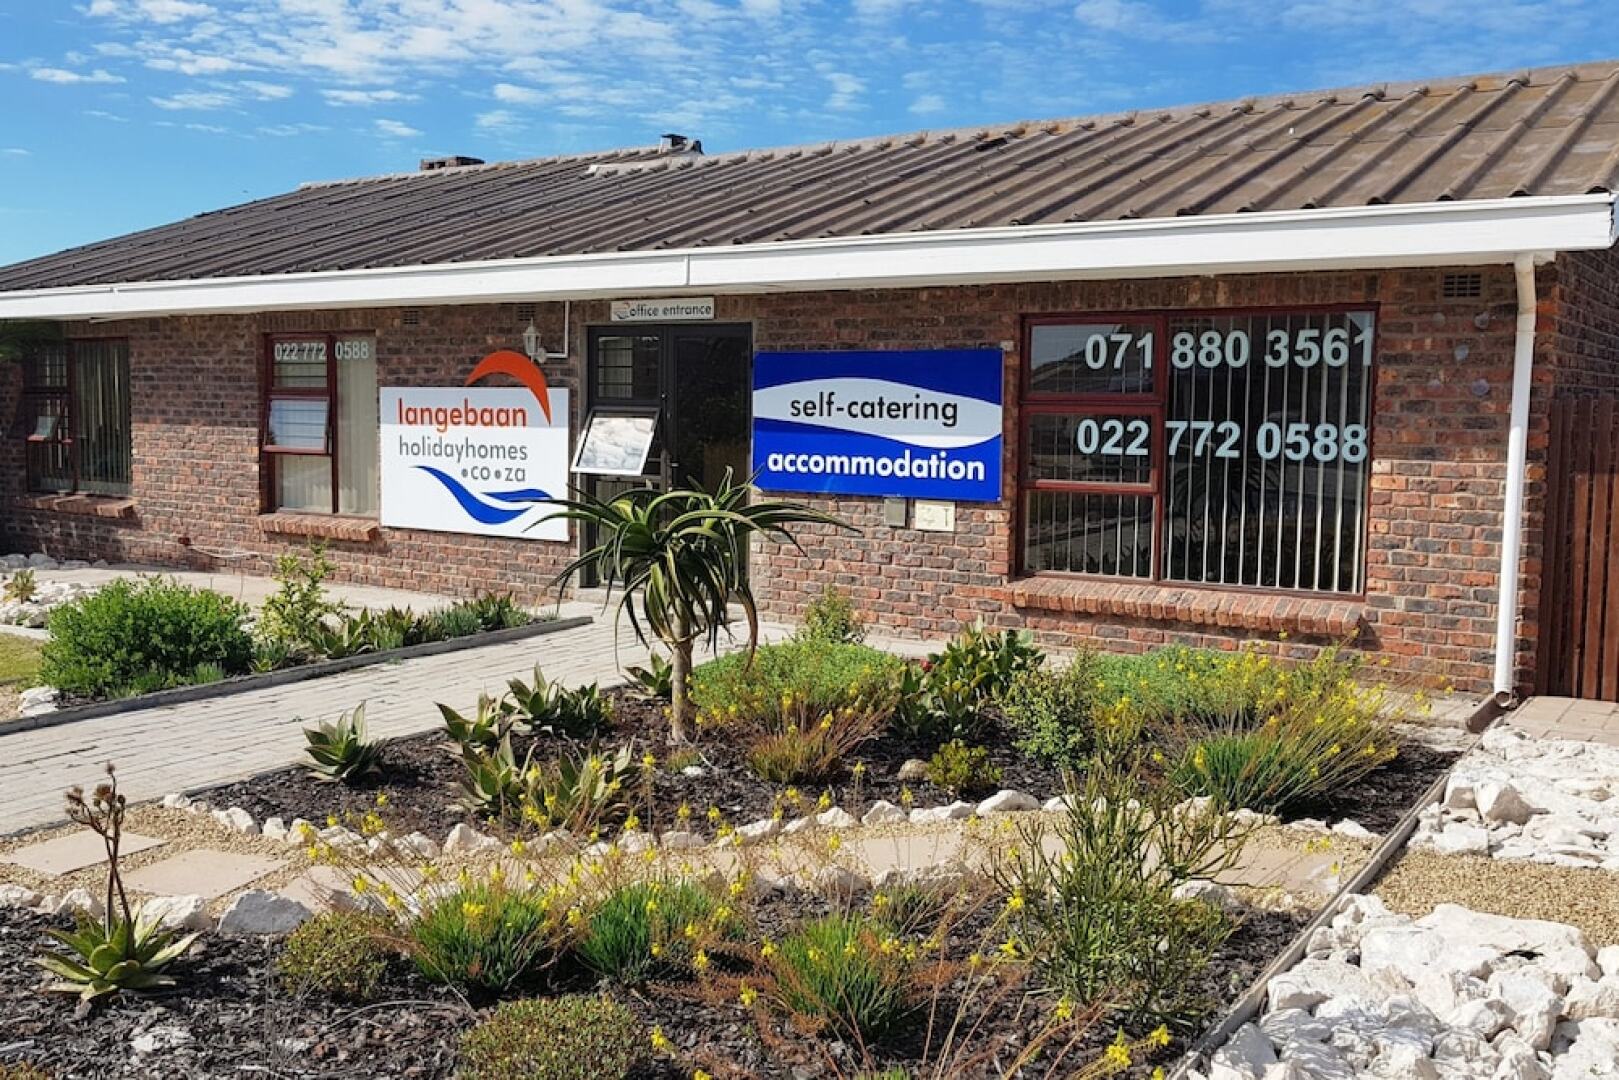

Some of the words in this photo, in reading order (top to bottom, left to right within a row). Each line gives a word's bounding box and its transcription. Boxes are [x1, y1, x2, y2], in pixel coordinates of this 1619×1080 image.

[630, 304, 659, 317] office
[663, 304, 712, 316] entrance
[274, 343, 299, 360] 022
[303, 342, 327, 360] 772
[334, 341, 369, 360] 0588
[1085, 332, 1154, 369] 071
[1171, 330, 1249, 369] 880
[1264, 327, 1373, 367] 3561
[398, 397, 527, 433] langebaan
[790, 391, 958, 427] self-catering
[399, 435, 528, 463] holidayhomes
[1076, 419, 1149, 456] 022
[1165, 420, 1240, 459] 772
[1256, 422, 1368, 463] 0588
[767, 449, 985, 481] accommodation
